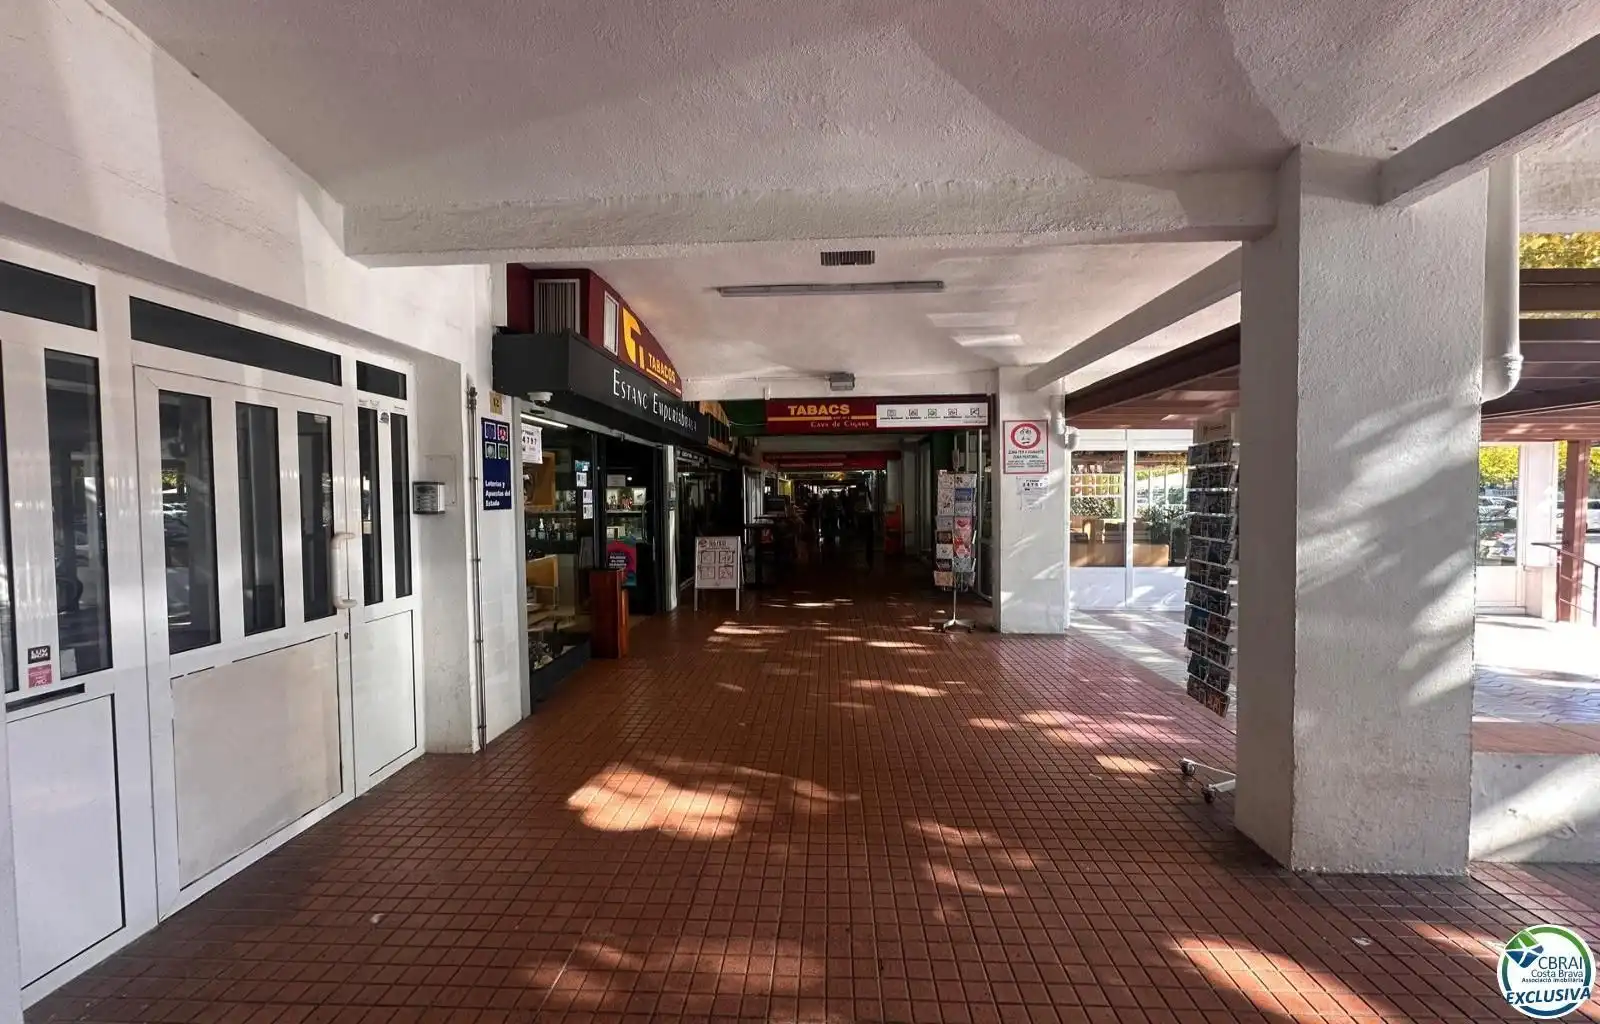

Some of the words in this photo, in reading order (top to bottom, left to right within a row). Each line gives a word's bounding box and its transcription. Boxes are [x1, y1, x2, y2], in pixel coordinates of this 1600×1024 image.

[648, 353, 676, 383] TABACOS
[613, 368, 648, 410] ESTANC
[787, 404, 850, 416] TABACS
